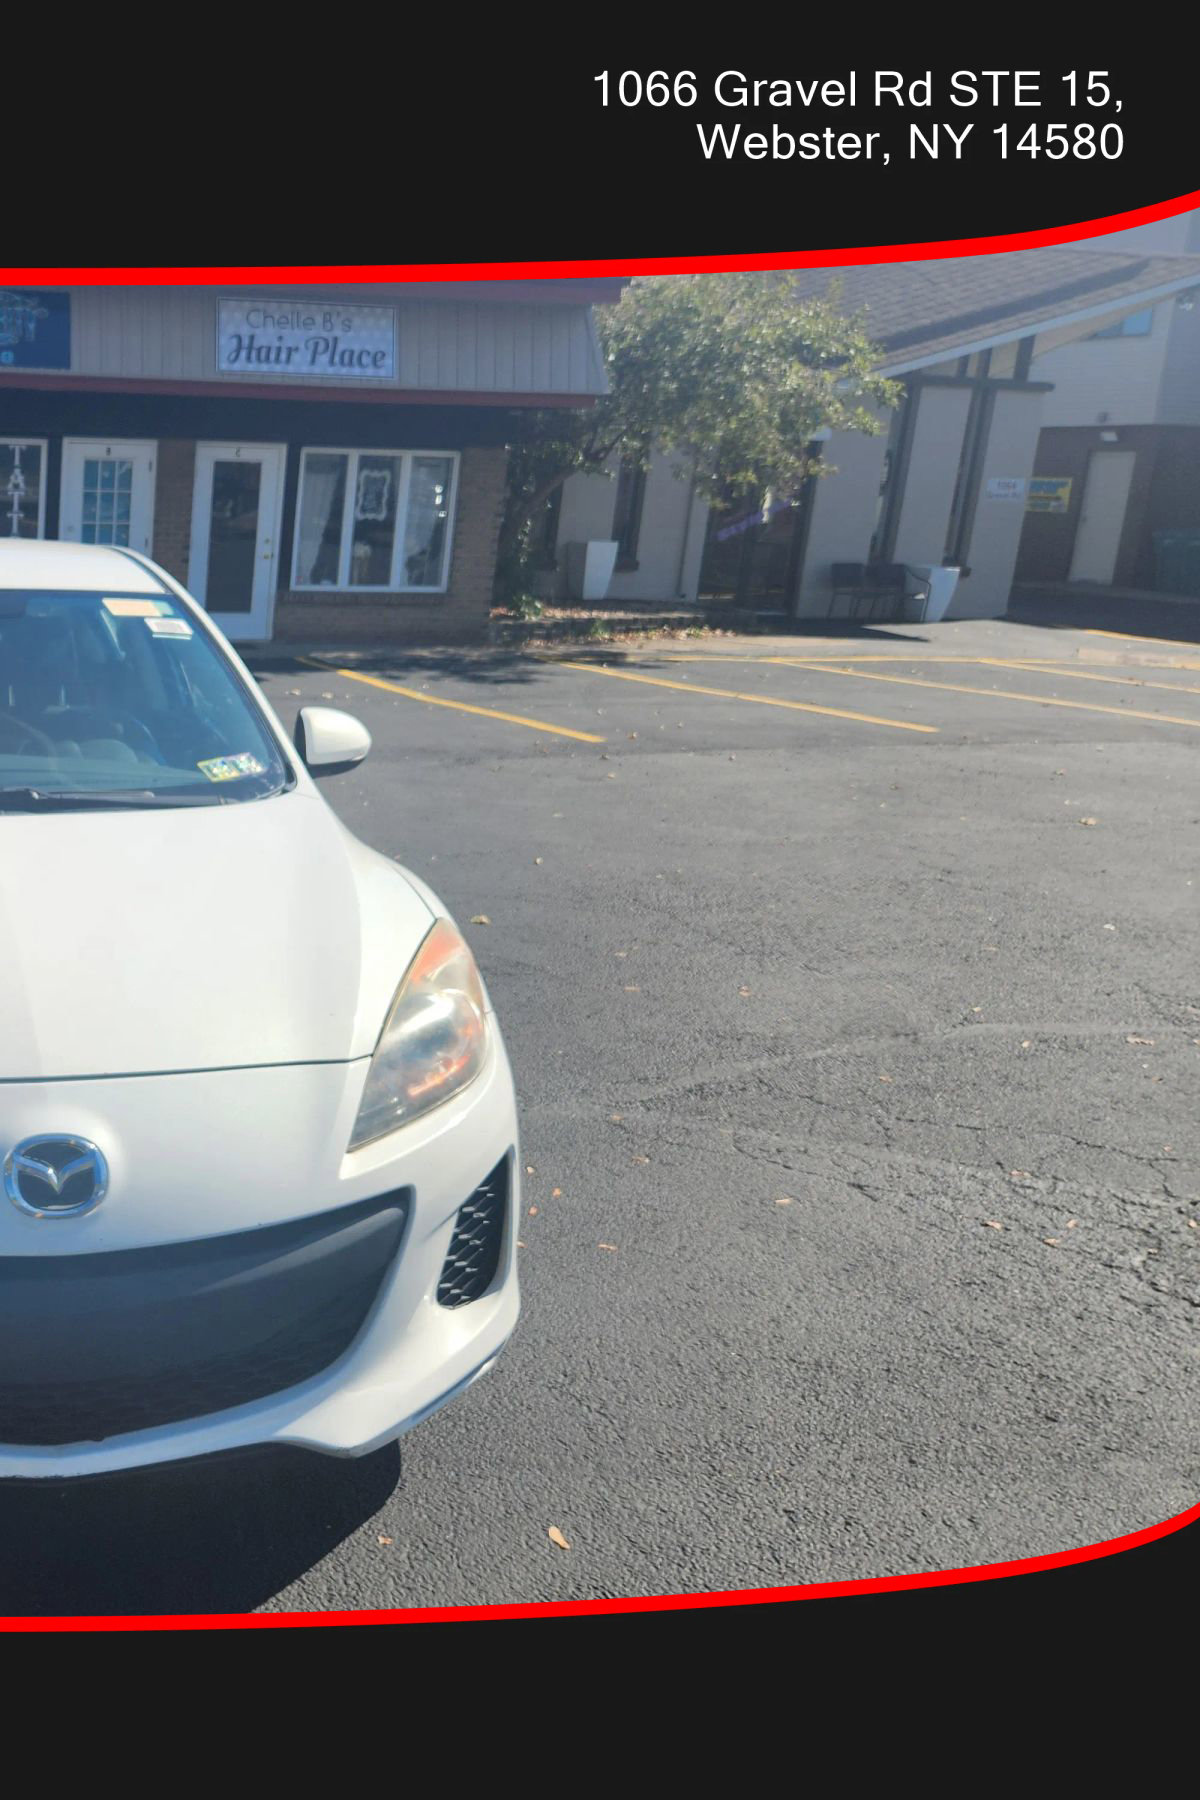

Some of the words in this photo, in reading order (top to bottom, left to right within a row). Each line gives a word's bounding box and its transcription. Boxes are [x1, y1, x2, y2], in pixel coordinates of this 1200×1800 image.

[246, 308, 317, 331] Chelle
[322, 311, 354, 333] B's
[227, 334, 299, 366] Hair
[304, 336, 387, 369] Place
